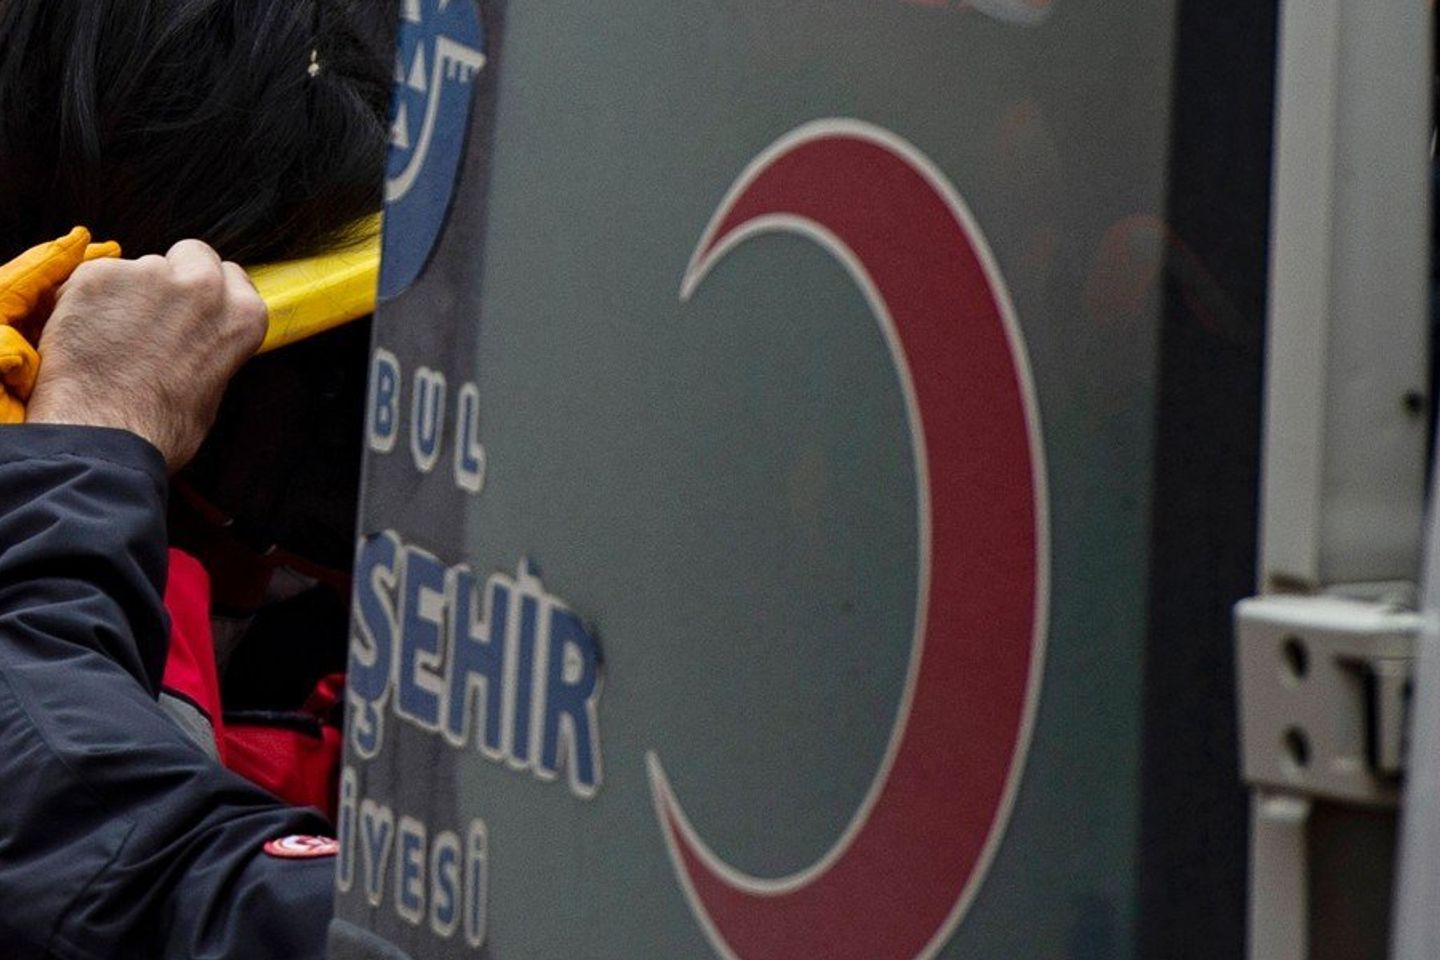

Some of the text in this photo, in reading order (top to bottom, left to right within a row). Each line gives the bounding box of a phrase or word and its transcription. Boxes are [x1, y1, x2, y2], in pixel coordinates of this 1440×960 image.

[367, 347, 486, 493] BUL
[348, 528, 604, 798] ŞEHİR
[336, 766, 488, 946] İYESİ
